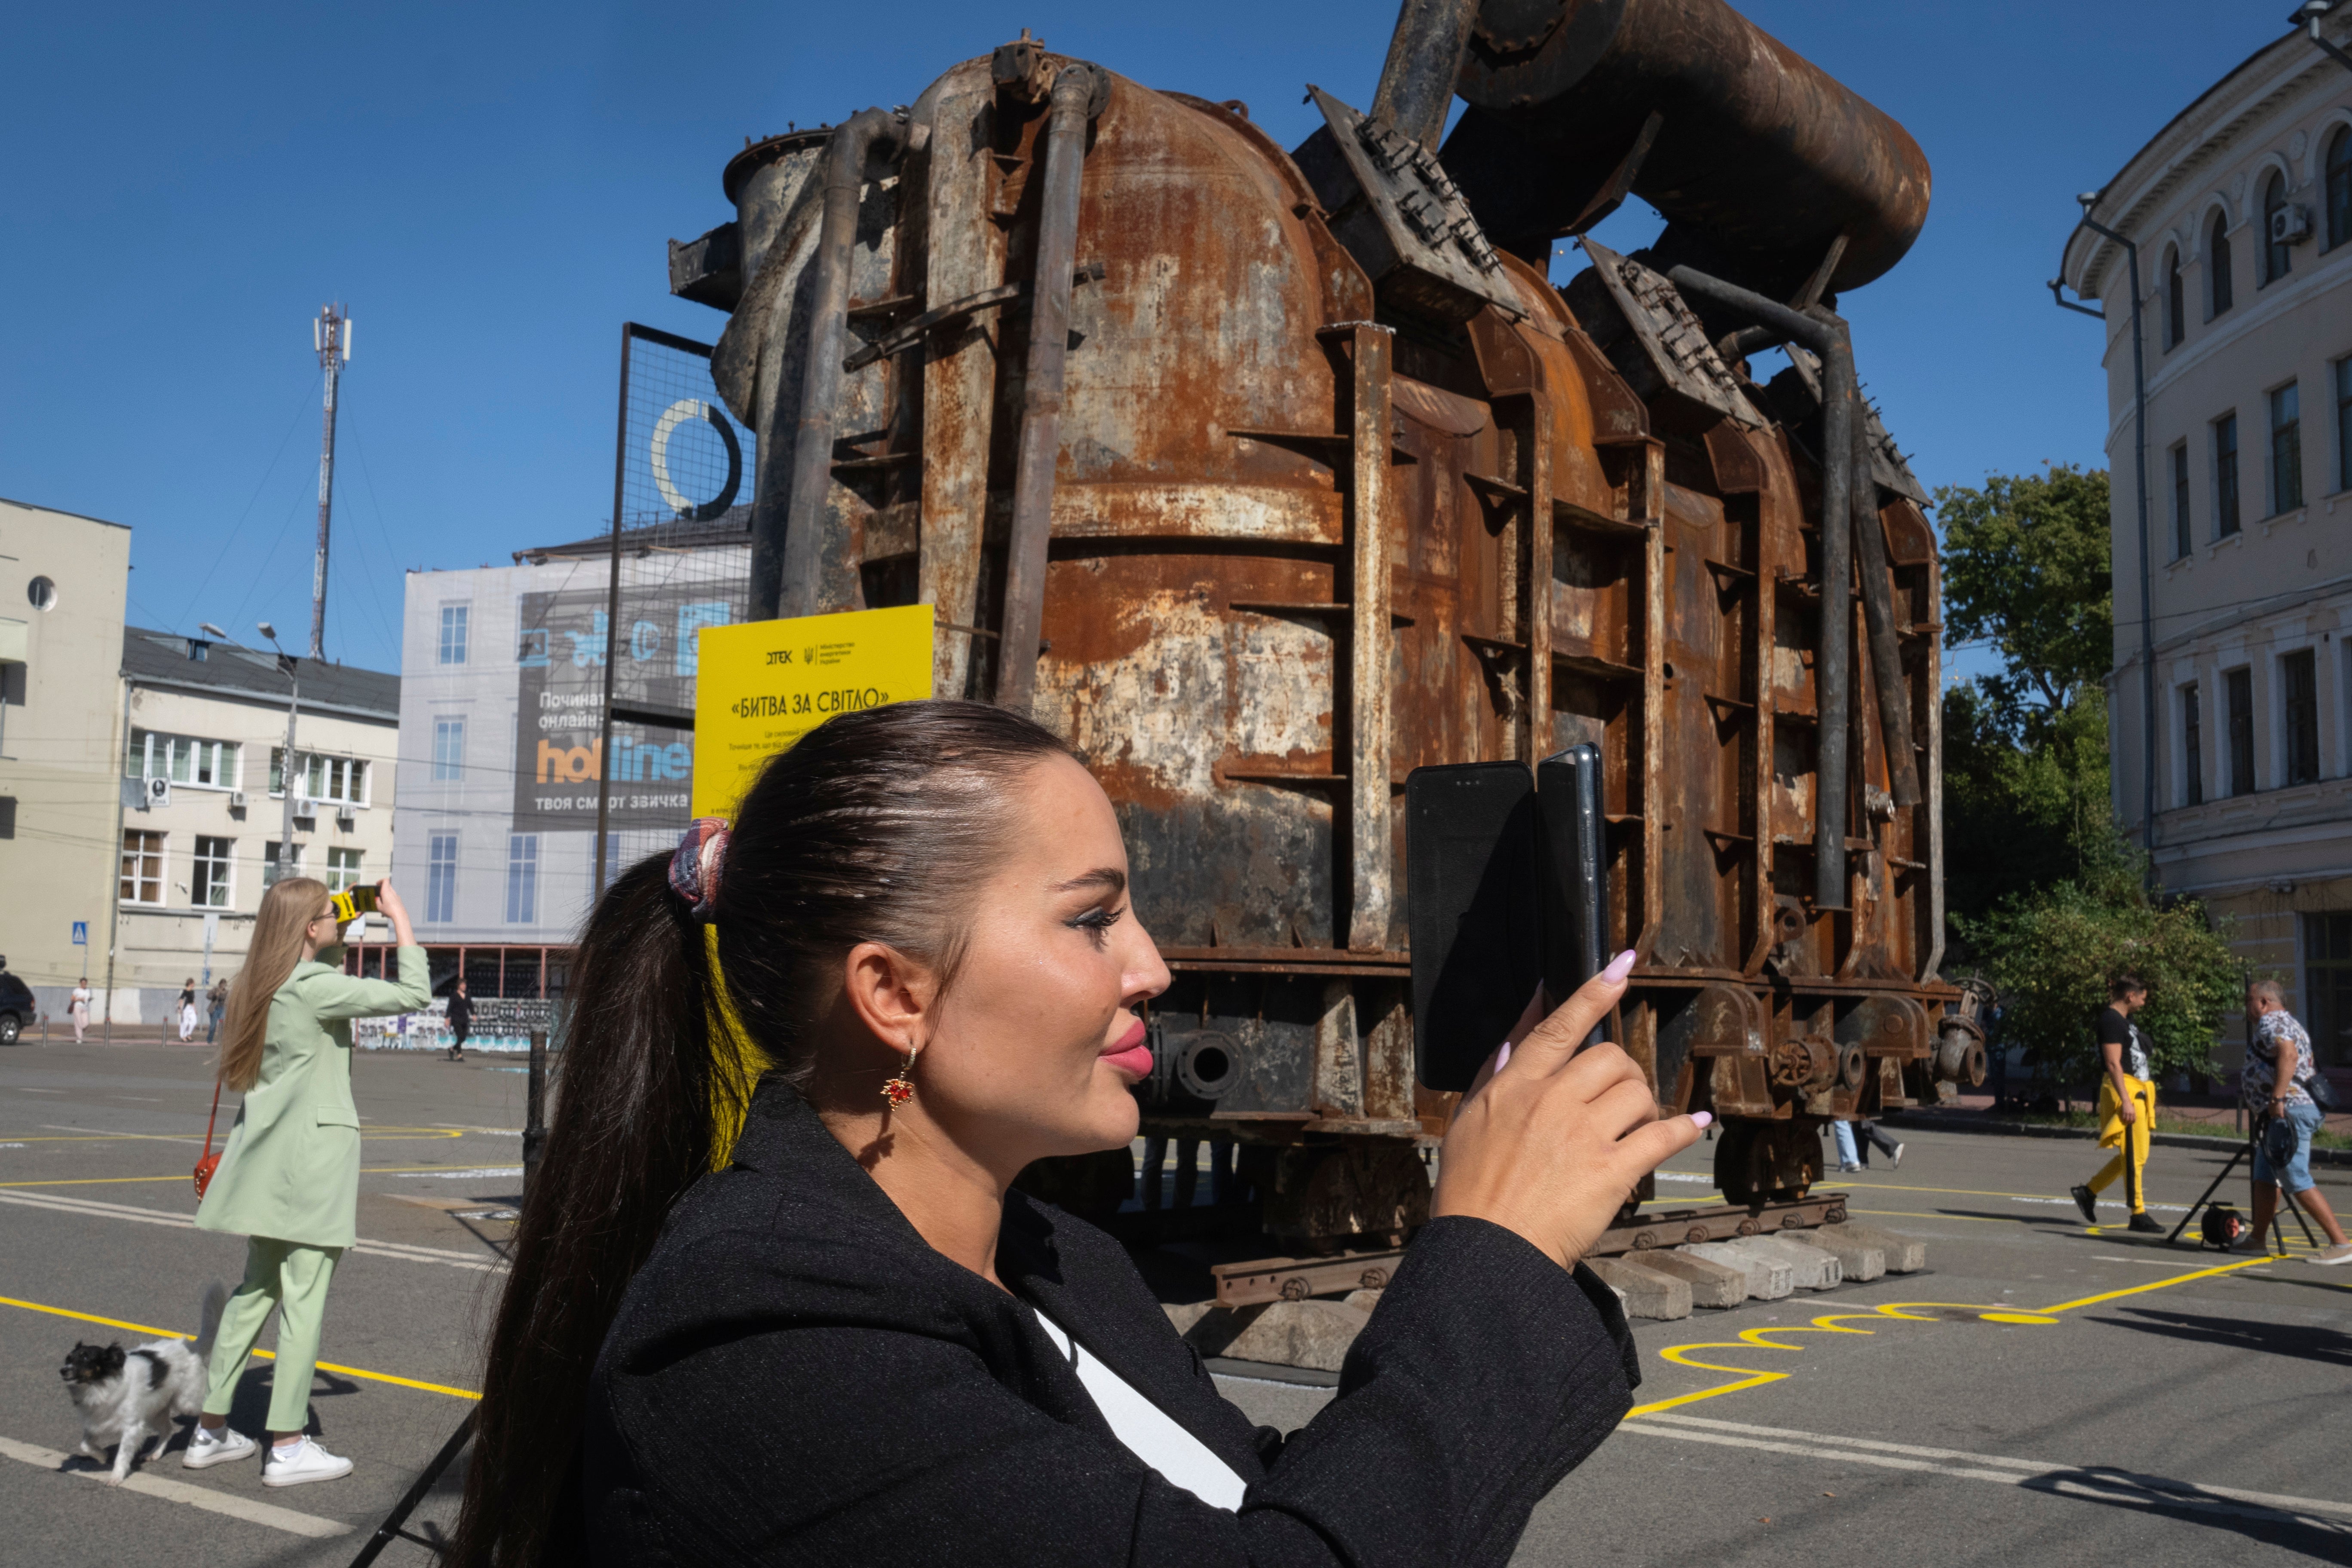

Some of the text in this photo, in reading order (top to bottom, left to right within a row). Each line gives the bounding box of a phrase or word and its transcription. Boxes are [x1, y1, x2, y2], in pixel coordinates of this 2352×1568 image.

[732, 695, 787, 718] «БИТВА
[793, 693, 812, 714] ЗА
[535, 794, 688, 813] твоя смрт звичка
